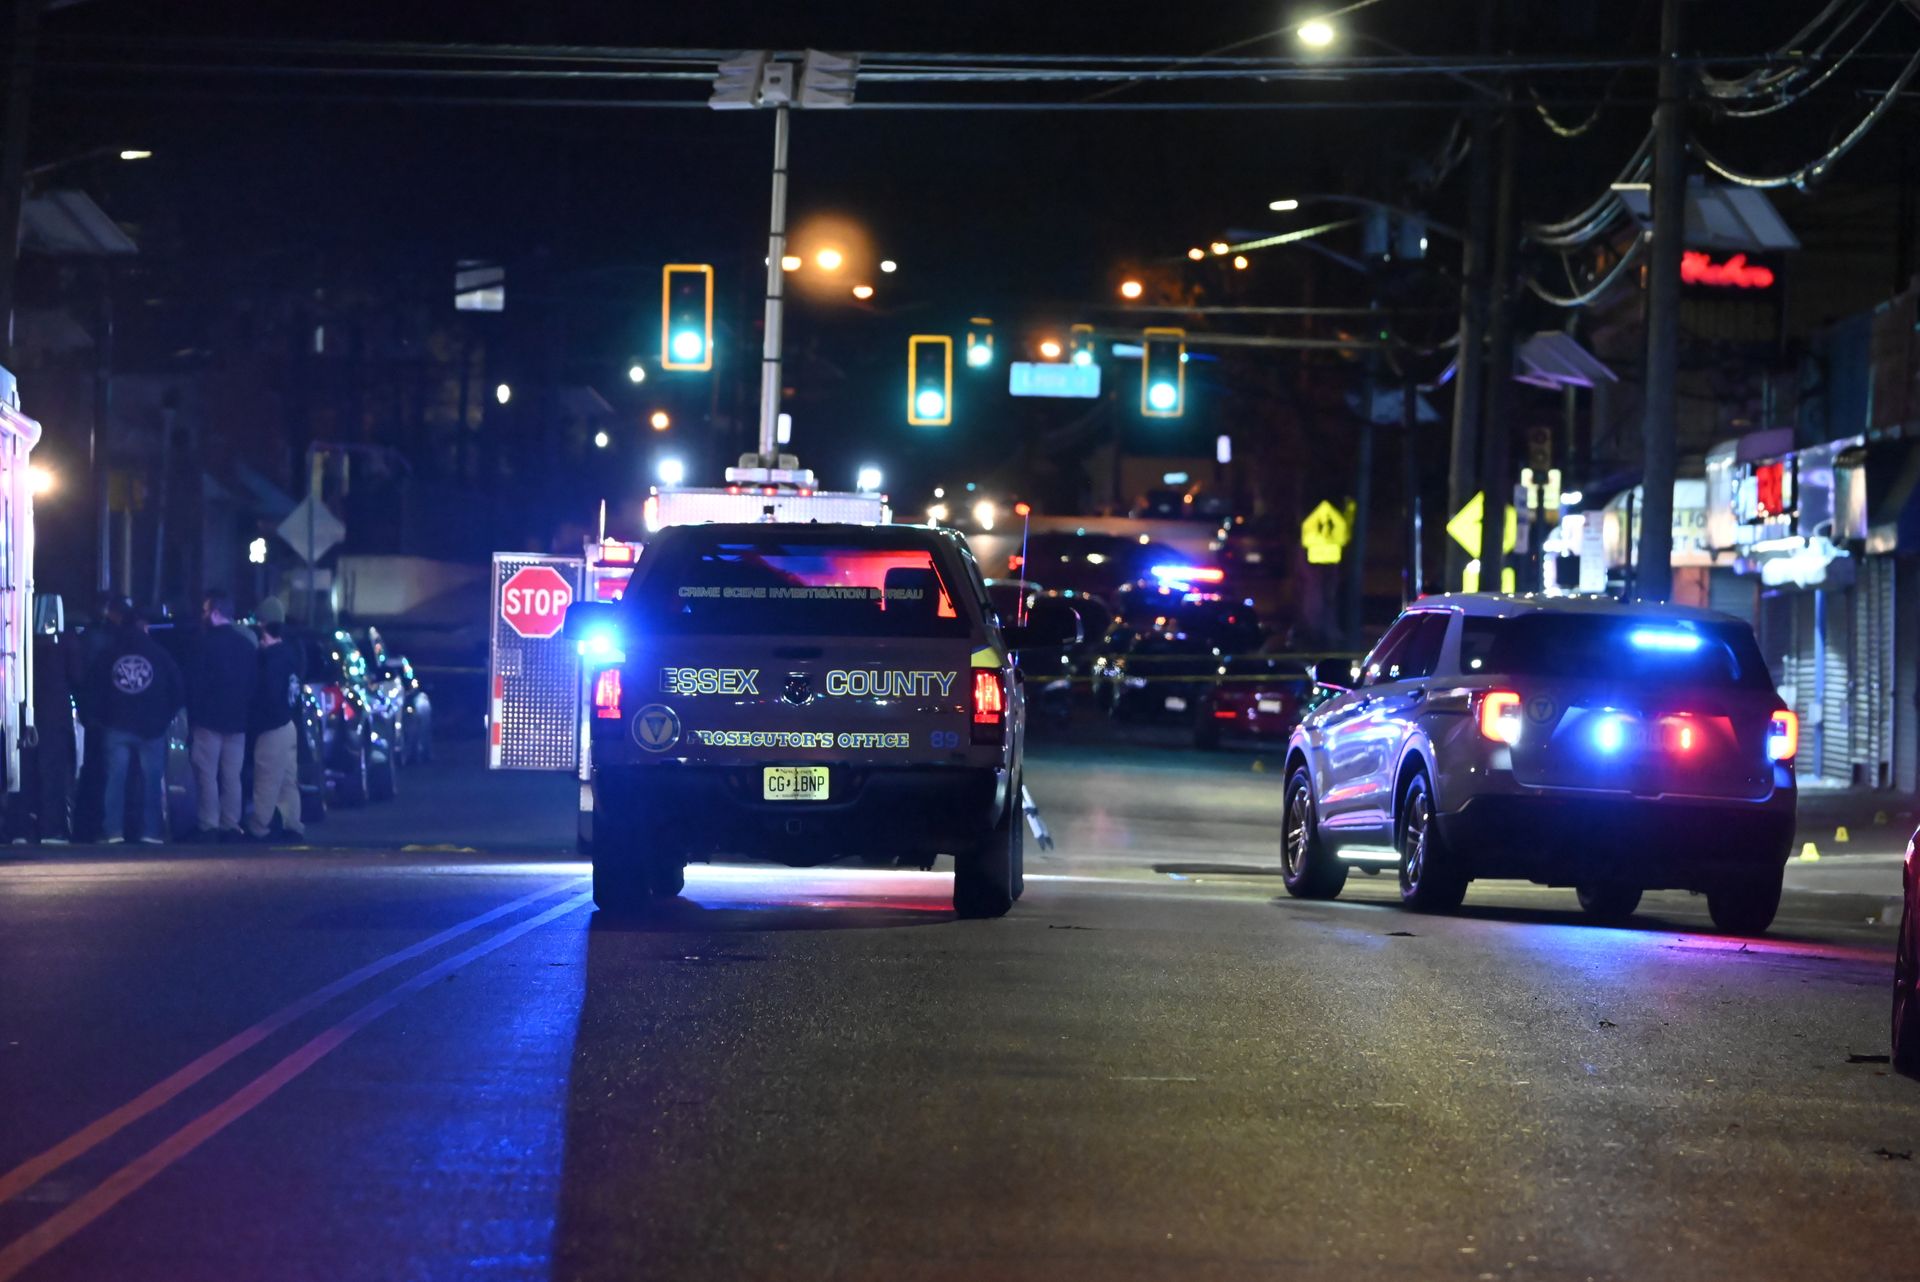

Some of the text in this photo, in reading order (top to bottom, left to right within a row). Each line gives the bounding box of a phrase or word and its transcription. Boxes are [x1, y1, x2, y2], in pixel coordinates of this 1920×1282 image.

[505, 588, 569, 616] STOP
[678, 586, 721, 598] CRIME
[723, 586, 766, 599] SCENE
[769, 587, 867, 599] INVESTIGATION
[659, 667, 957, 697] ESSEX COUNTY
[686, 729, 960, 749] PROSECUTOR'S OFFICE 89
